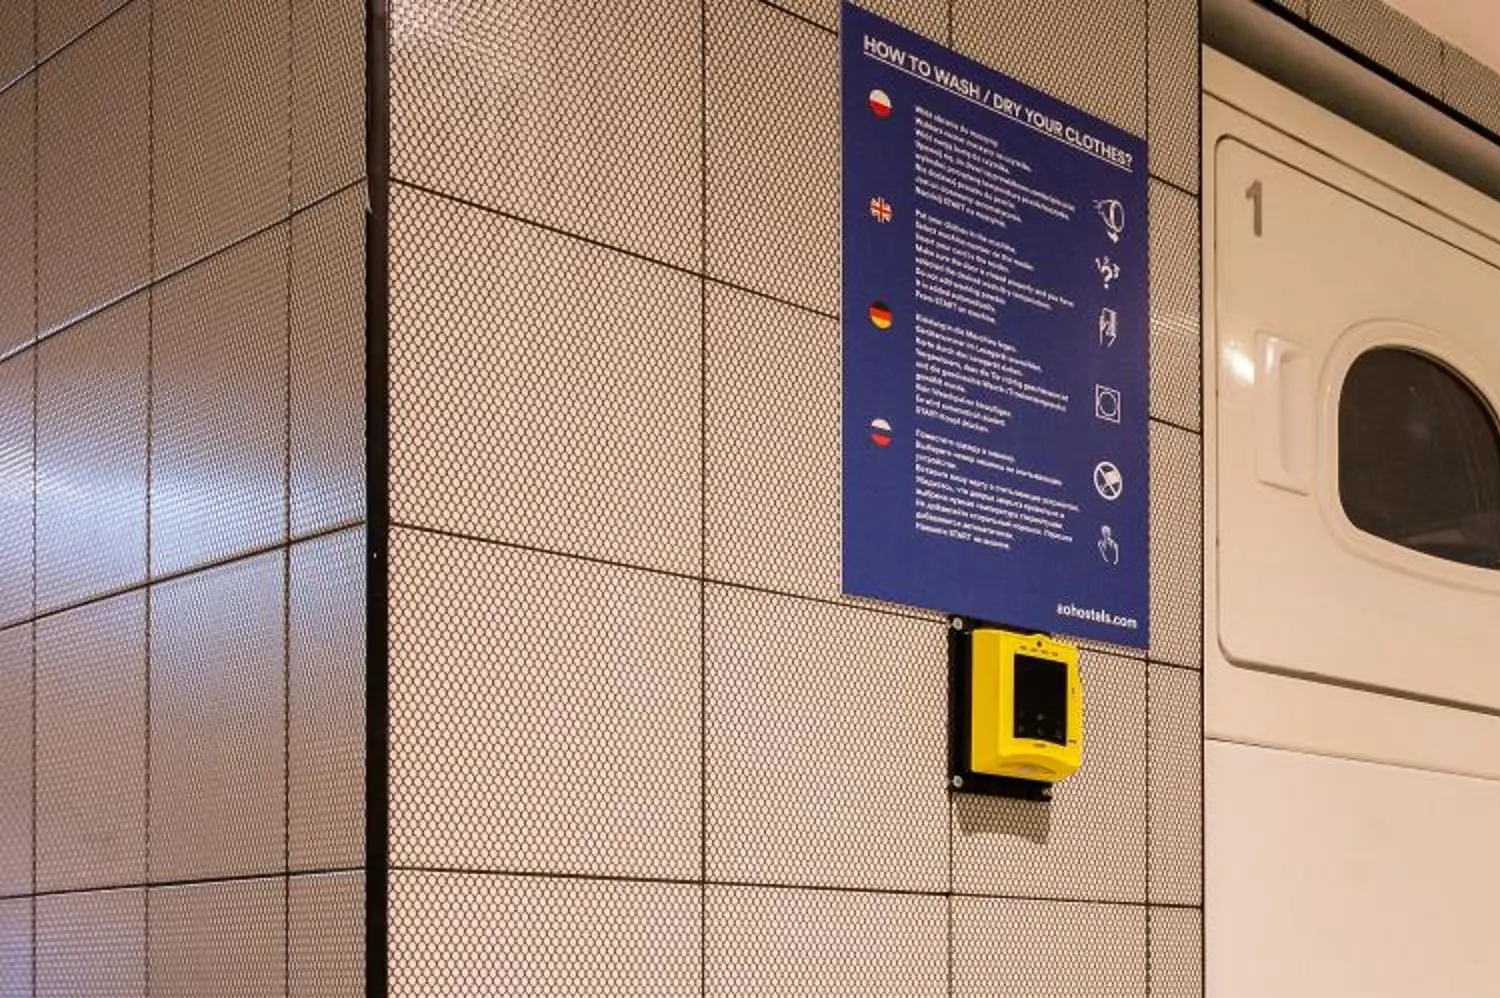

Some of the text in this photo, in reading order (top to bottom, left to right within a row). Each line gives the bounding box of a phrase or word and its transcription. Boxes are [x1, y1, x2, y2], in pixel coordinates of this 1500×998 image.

[863, 35, 905, 64] HOW
[908, 55, 931, 78] TO
[934, 65, 981, 98] WASH
[993, 93, 1023, 117] DRY
[1024, 107, 1063, 136] YOUR
[1065, 128, 1133, 166] CLOTHES?
[1244, 179, 1264, 237] 1
[1057, 603, 1136, 629] aohostels.com
